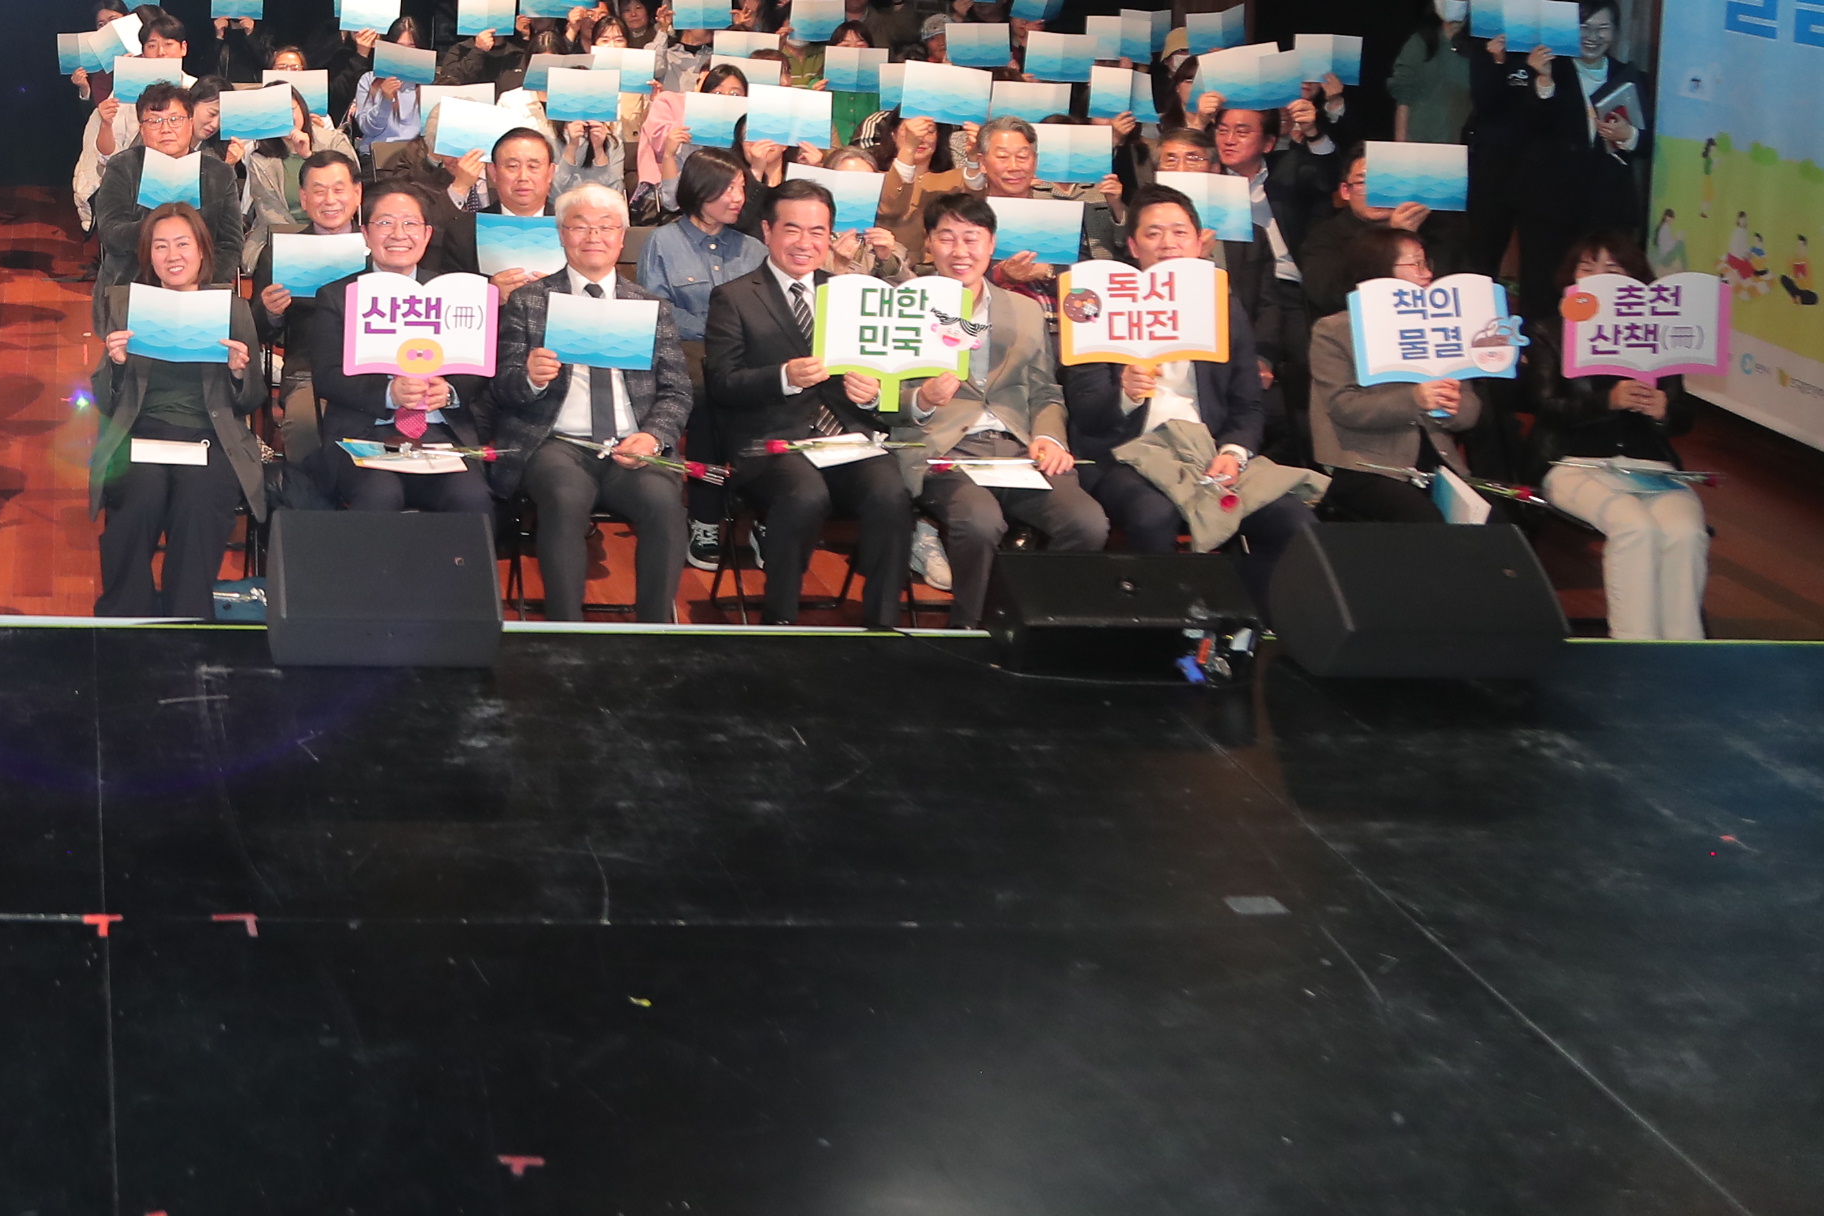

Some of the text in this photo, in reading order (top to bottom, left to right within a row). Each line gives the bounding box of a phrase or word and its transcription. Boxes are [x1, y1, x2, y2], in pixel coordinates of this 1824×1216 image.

[860, 287, 930, 319] 대한
[1106, 271, 1177, 303] 독서
[1392, 287, 1463, 320] 책의
[1614, 284, 1682, 318] 춘천
[362, 295, 485, 335] 산책(冊)
[1108, 309, 1180, 342] 대전
[859, 325, 923, 357] 민국
[1398, 327, 1466, 361] 물결
